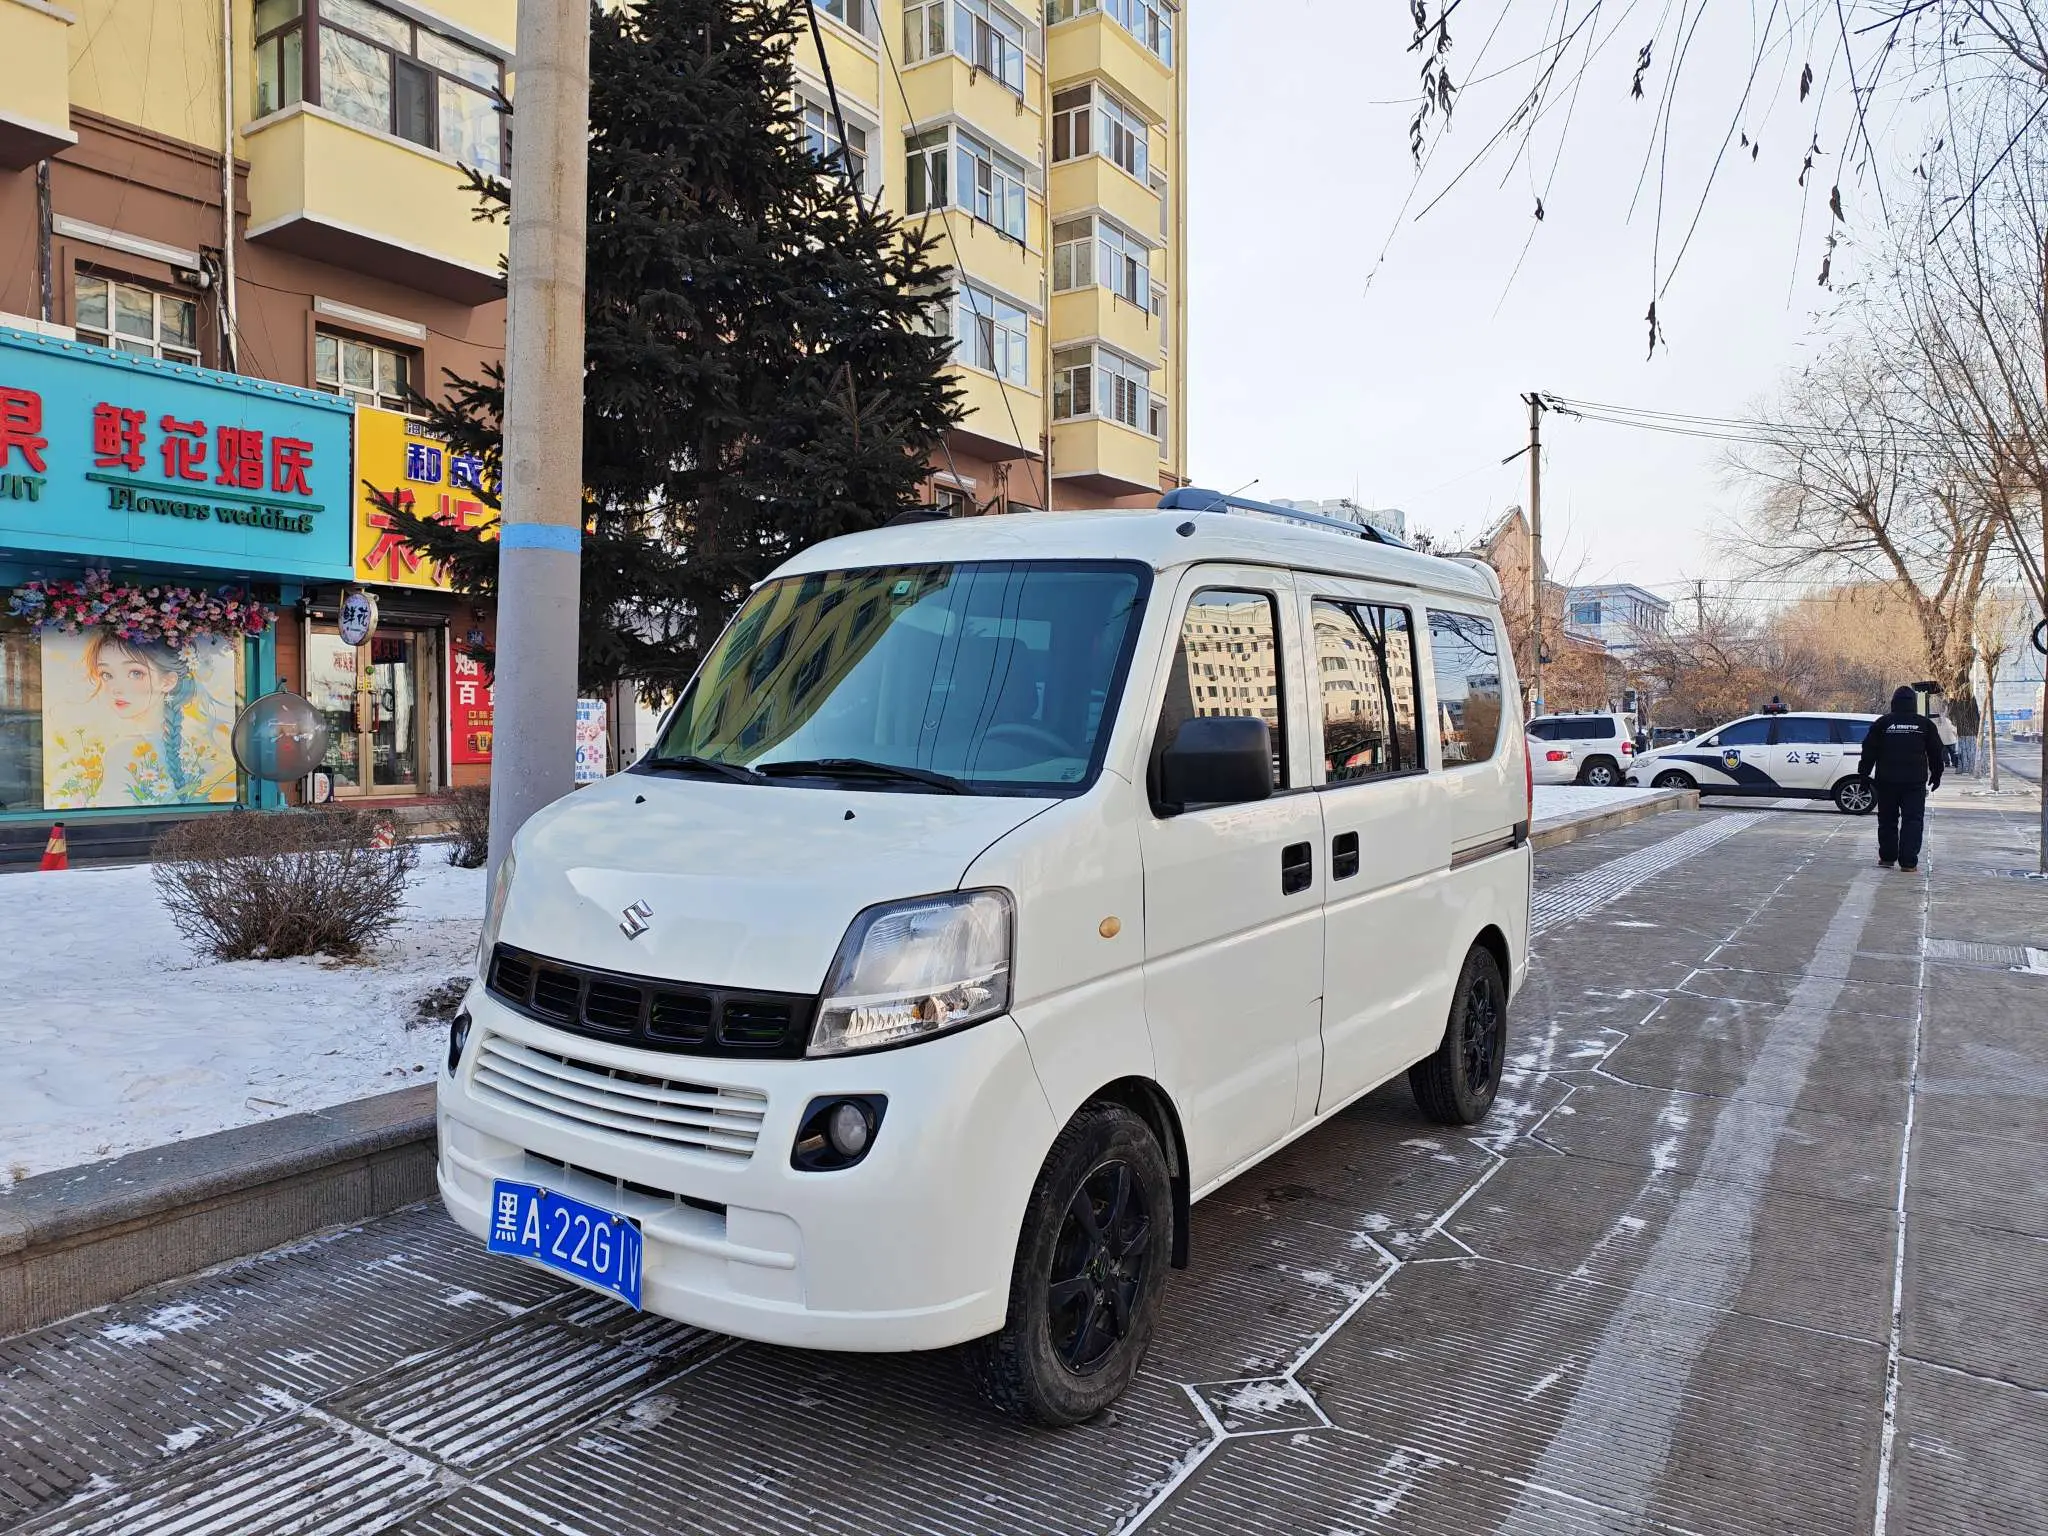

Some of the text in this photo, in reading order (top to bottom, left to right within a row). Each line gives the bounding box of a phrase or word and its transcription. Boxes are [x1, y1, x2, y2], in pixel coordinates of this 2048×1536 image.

[93, 402, 313, 495] 鲜花婚庆
[108, 487, 313, 534] Flowers wedding
[343, 605, 368, 627] 鲜花
[1786, 751, 1820, 764] 公安
